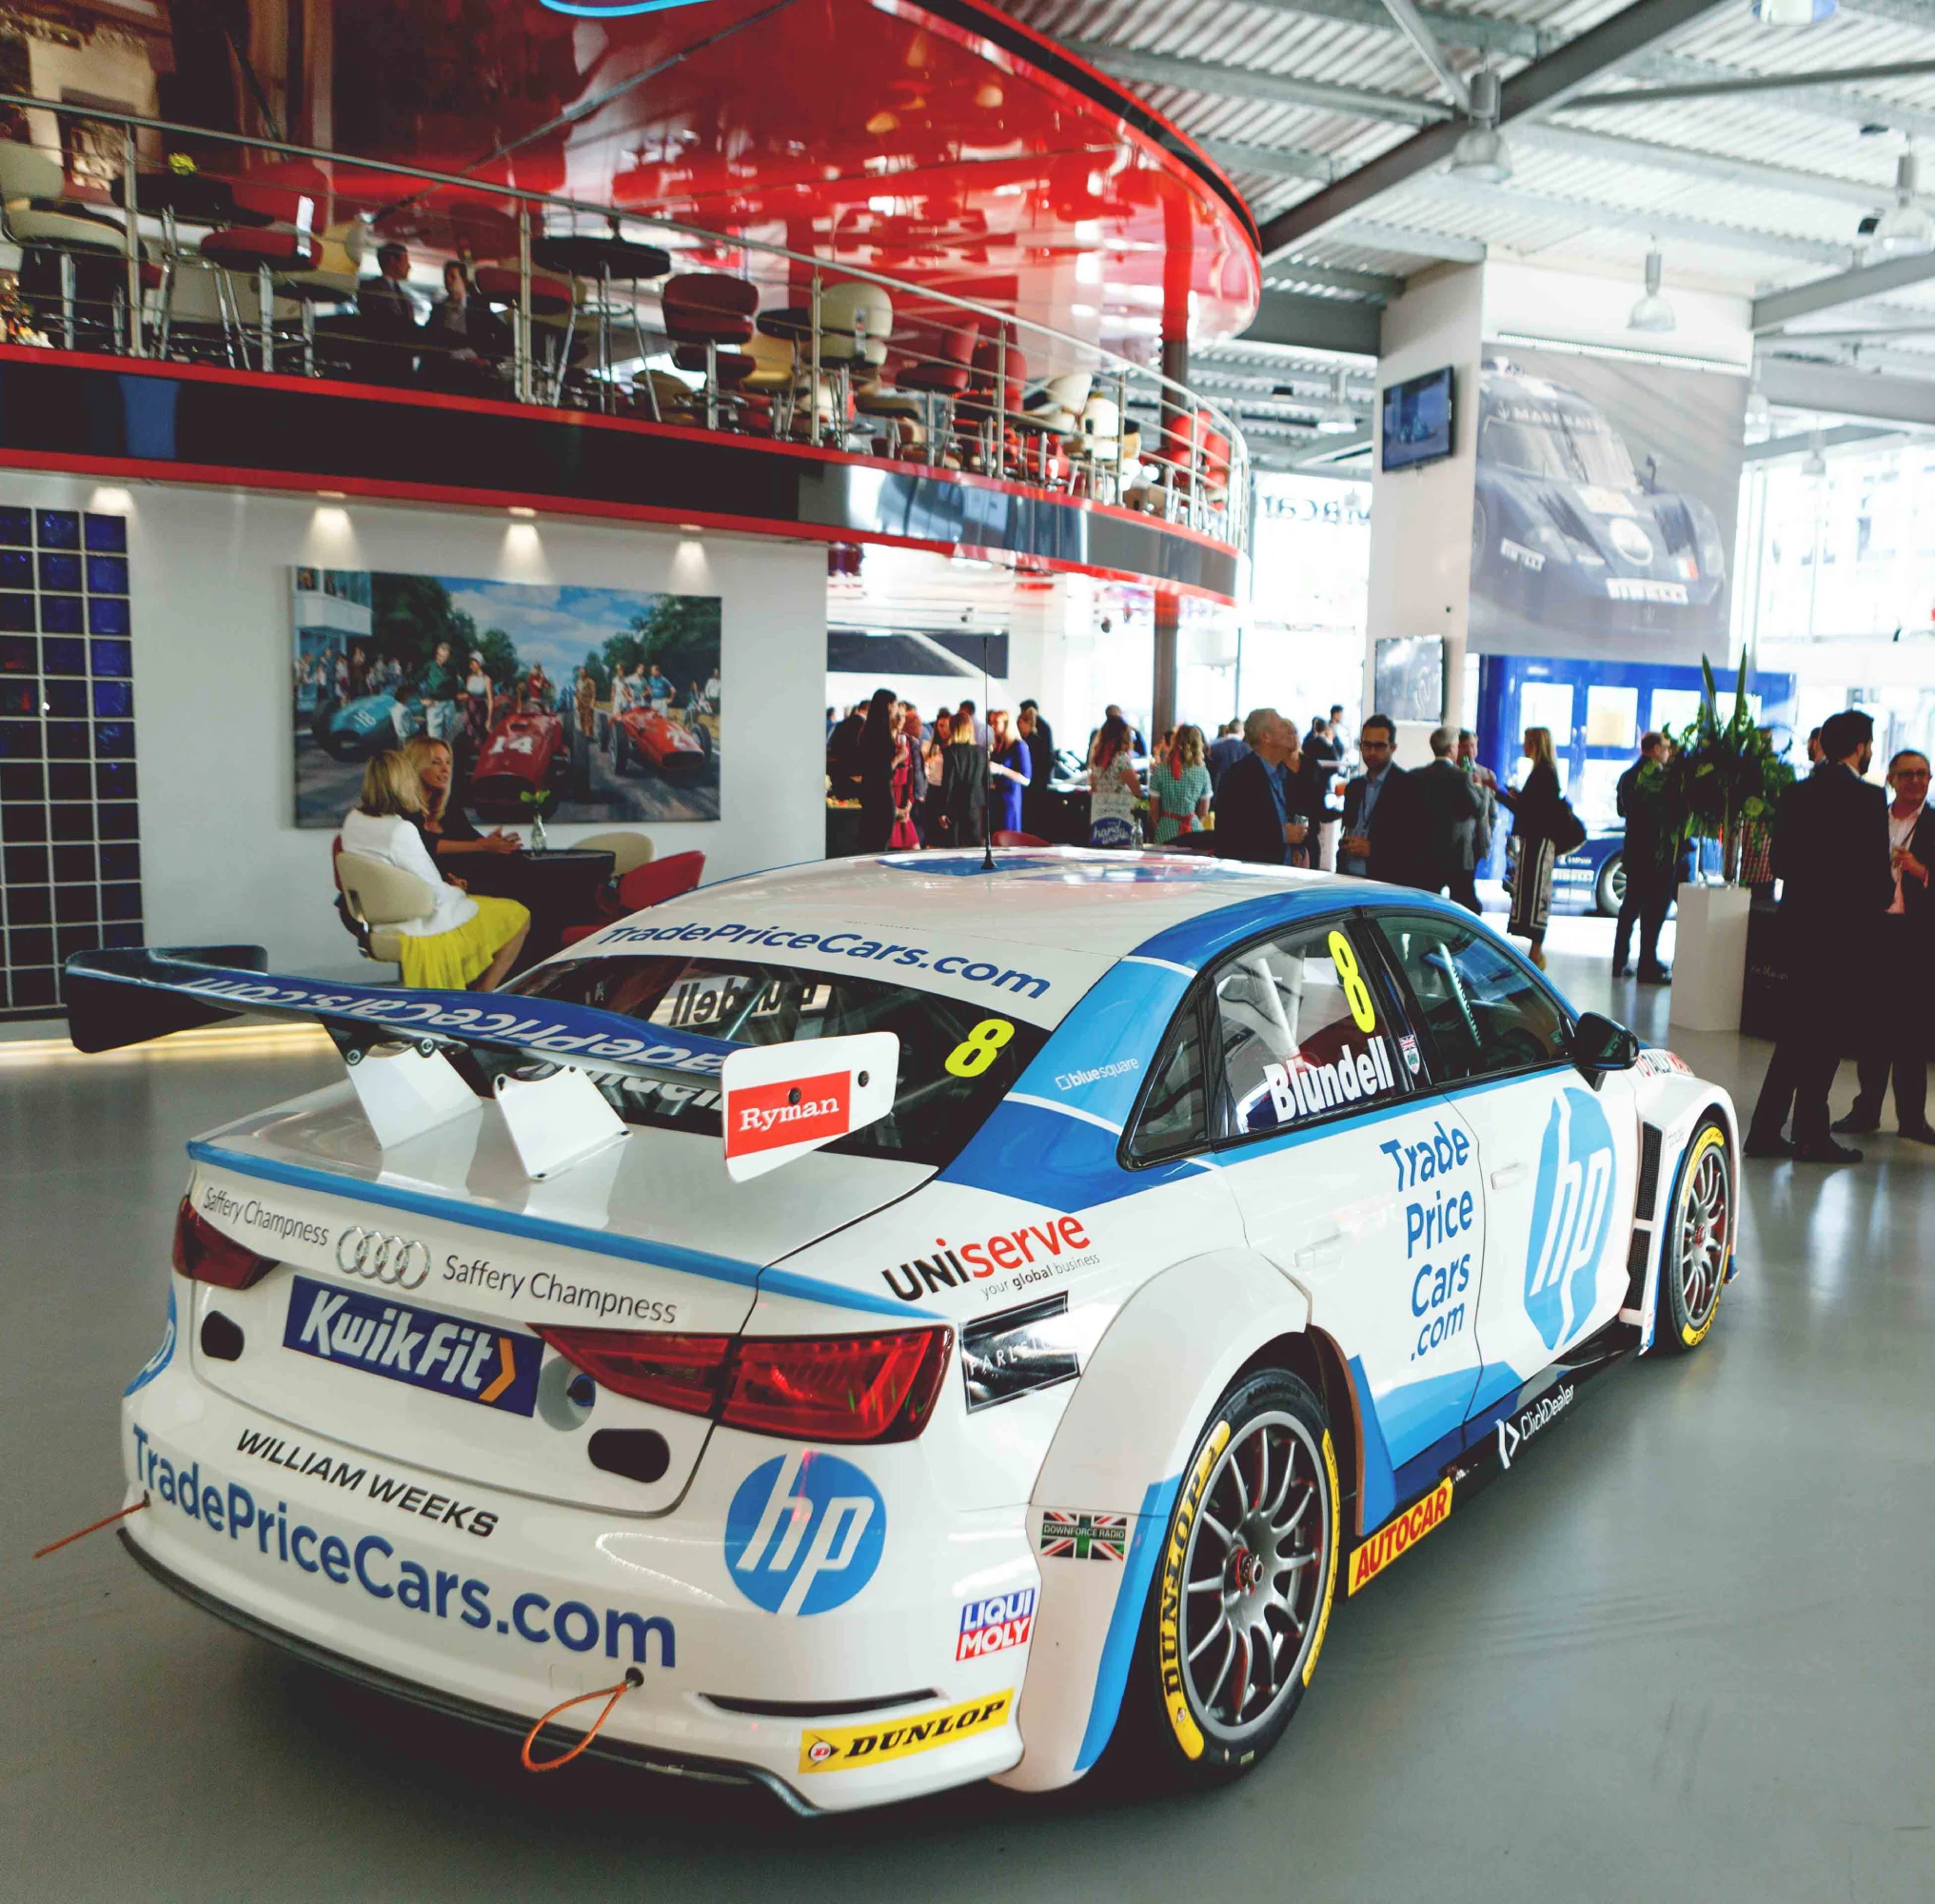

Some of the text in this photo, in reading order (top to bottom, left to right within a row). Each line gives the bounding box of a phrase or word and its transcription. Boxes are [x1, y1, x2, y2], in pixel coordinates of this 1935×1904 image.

[488, 735, 534, 755] 14
[597, 922, 1051, 1000] TradePriceCars.com
[1328, 930, 1375, 1033] 8
[179, 977, 722, 1072] adePriceCars.com
[945, 1019, 1015, 1078] 8
[739, 1095, 839, 1132] Ryman
[1263, 1036, 1395, 1122] Blundell
[1380, 1122, 1470, 1192] Trade
[203, 1186, 329, 1246] Saffery Champness
[1406, 1188, 1473, 1259] Price
[1529, 1091, 1611, 1350] hp
[443, 1255, 678, 1324] Saffery Champness
[981, 1253, 1100, 1301] your global business
[1411, 1251, 1471, 1317] Cars
[1411, 1300, 1464, 1361] .com
[1520, 1384, 1575, 1441] ClickDealer
[236, 1428, 499, 1538] WILLIAM WEEKS
[132, 1423, 677, 1669] TradePriceCars.com
[735, 1451, 876, 1616] hp
[1043, 1524, 1126, 1538] DOWNFORCE RADIO
[1355, 1486, 1448, 1587] AUTOCAR
[960, 1589, 1035, 1632] LIQUI
[1160, 1474, 1202, 1697] DUNLOP
[958, 1617, 1030, 1660] MOLY
[844, 1698, 1005, 1758] DUNLOP
